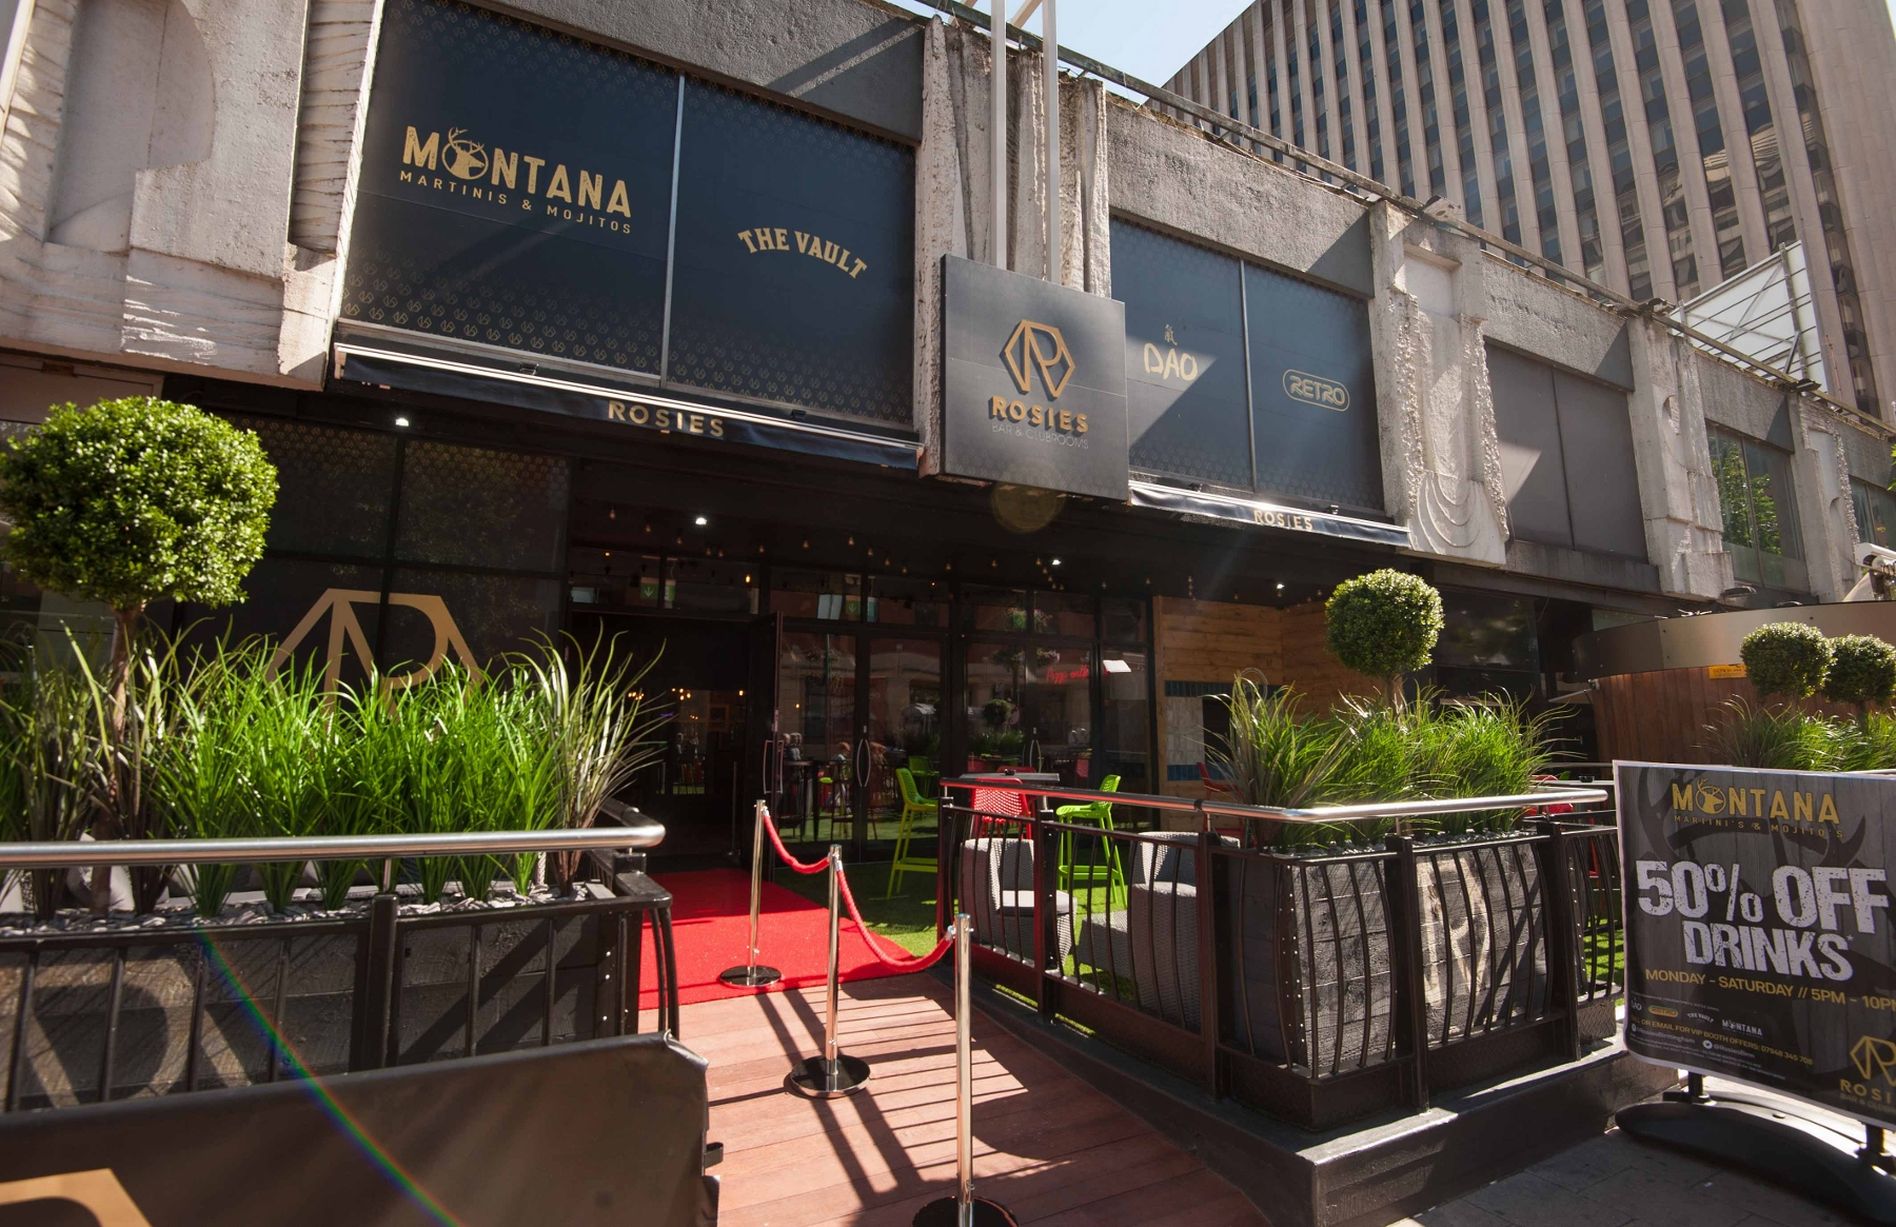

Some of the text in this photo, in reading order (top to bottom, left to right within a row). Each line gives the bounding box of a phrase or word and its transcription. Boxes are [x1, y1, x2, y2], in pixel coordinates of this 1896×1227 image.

[402, 125, 632, 218] MONTANA
[400, 170, 632, 234] MARTINIS & MOJITOS
[737, 227, 868, 279] THE VAULT
[1144, 342, 1198, 381] DAO
[1289, 375, 1346, 406] RETRO
[607, 400, 724, 437] ROSIES
[990, 396, 1089, 435] ROSIES
[992, 422, 1089, 449] BAR & CLUBROOMS
[1254, 509, 1313, 531] ROSIES
[1671, 778, 1841, 825] MONTANA
[1674, 815, 1844, 838] MARTINI'S & MOJITO'S
[1635, 859, 1889, 934] 50% OFF
[1645, 968, 1706, 985] MONDAY
[1718, 976, 1794, 998] SATURDAY
[1797, 986, 1808, 998] //
[1811, 988, 1846, 1005] 5PM
[1861, 995, 1896, 1012] 10P
[1651, 1020, 1675, 1031] EMAIL
[1675, 1024, 1690, 1034] FOR
[1691, 1027, 1702, 1036] VIP
[1703, 1030, 1729, 1042] BOOTH
